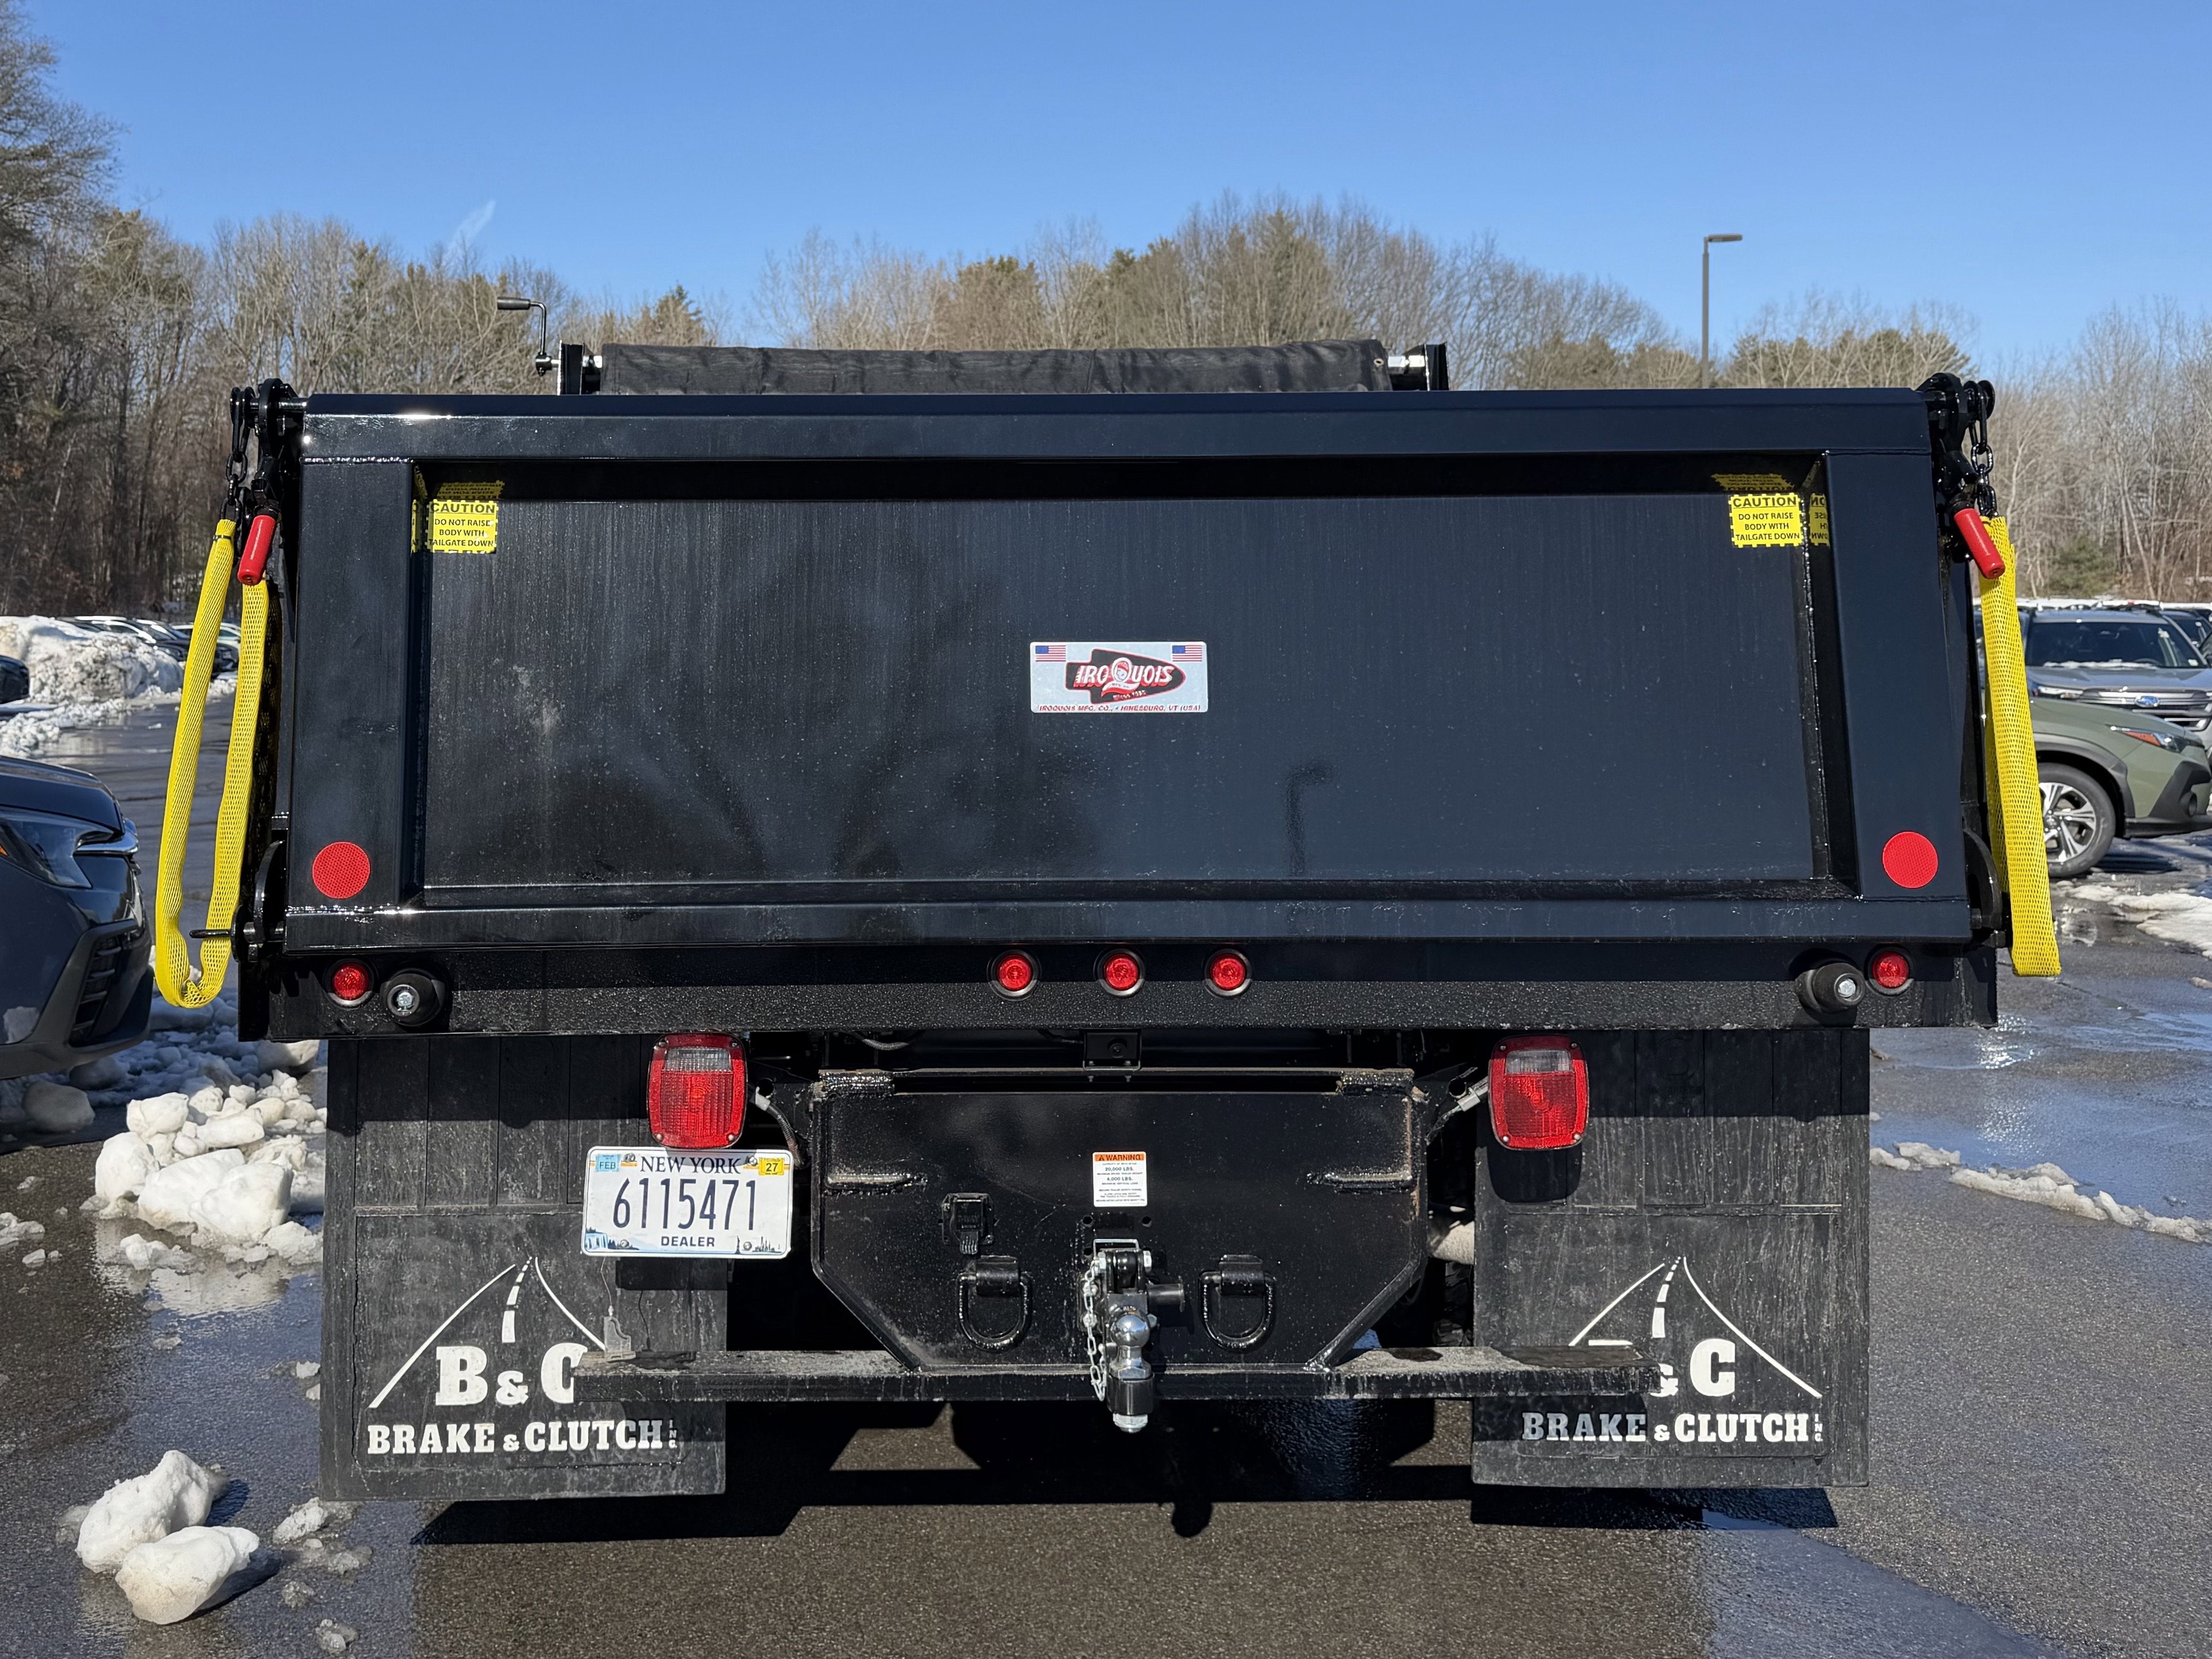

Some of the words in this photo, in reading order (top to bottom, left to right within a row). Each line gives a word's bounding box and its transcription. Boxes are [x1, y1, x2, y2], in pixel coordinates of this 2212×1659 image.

[430, 503, 495, 513] CAUTION
[1733, 497, 1797, 507] CAUTION
[1074, 658, 1174, 694] IROQUOIS
[640, 1156, 686, 1173] NEW
[690, 1157, 741, 1174] YORK
[766, 1163, 779, 1172] 27
[613, 1177, 756, 1230] 6115471
[661, 1236, 715, 1247] DEALER
[1522, 1412, 1646, 1441] BRAKE
[1674, 1413, 1808, 1442] CLUTCH
[367, 1423, 495, 1454] BRAKE
[524, 1420, 663, 1452] CLUTCH
